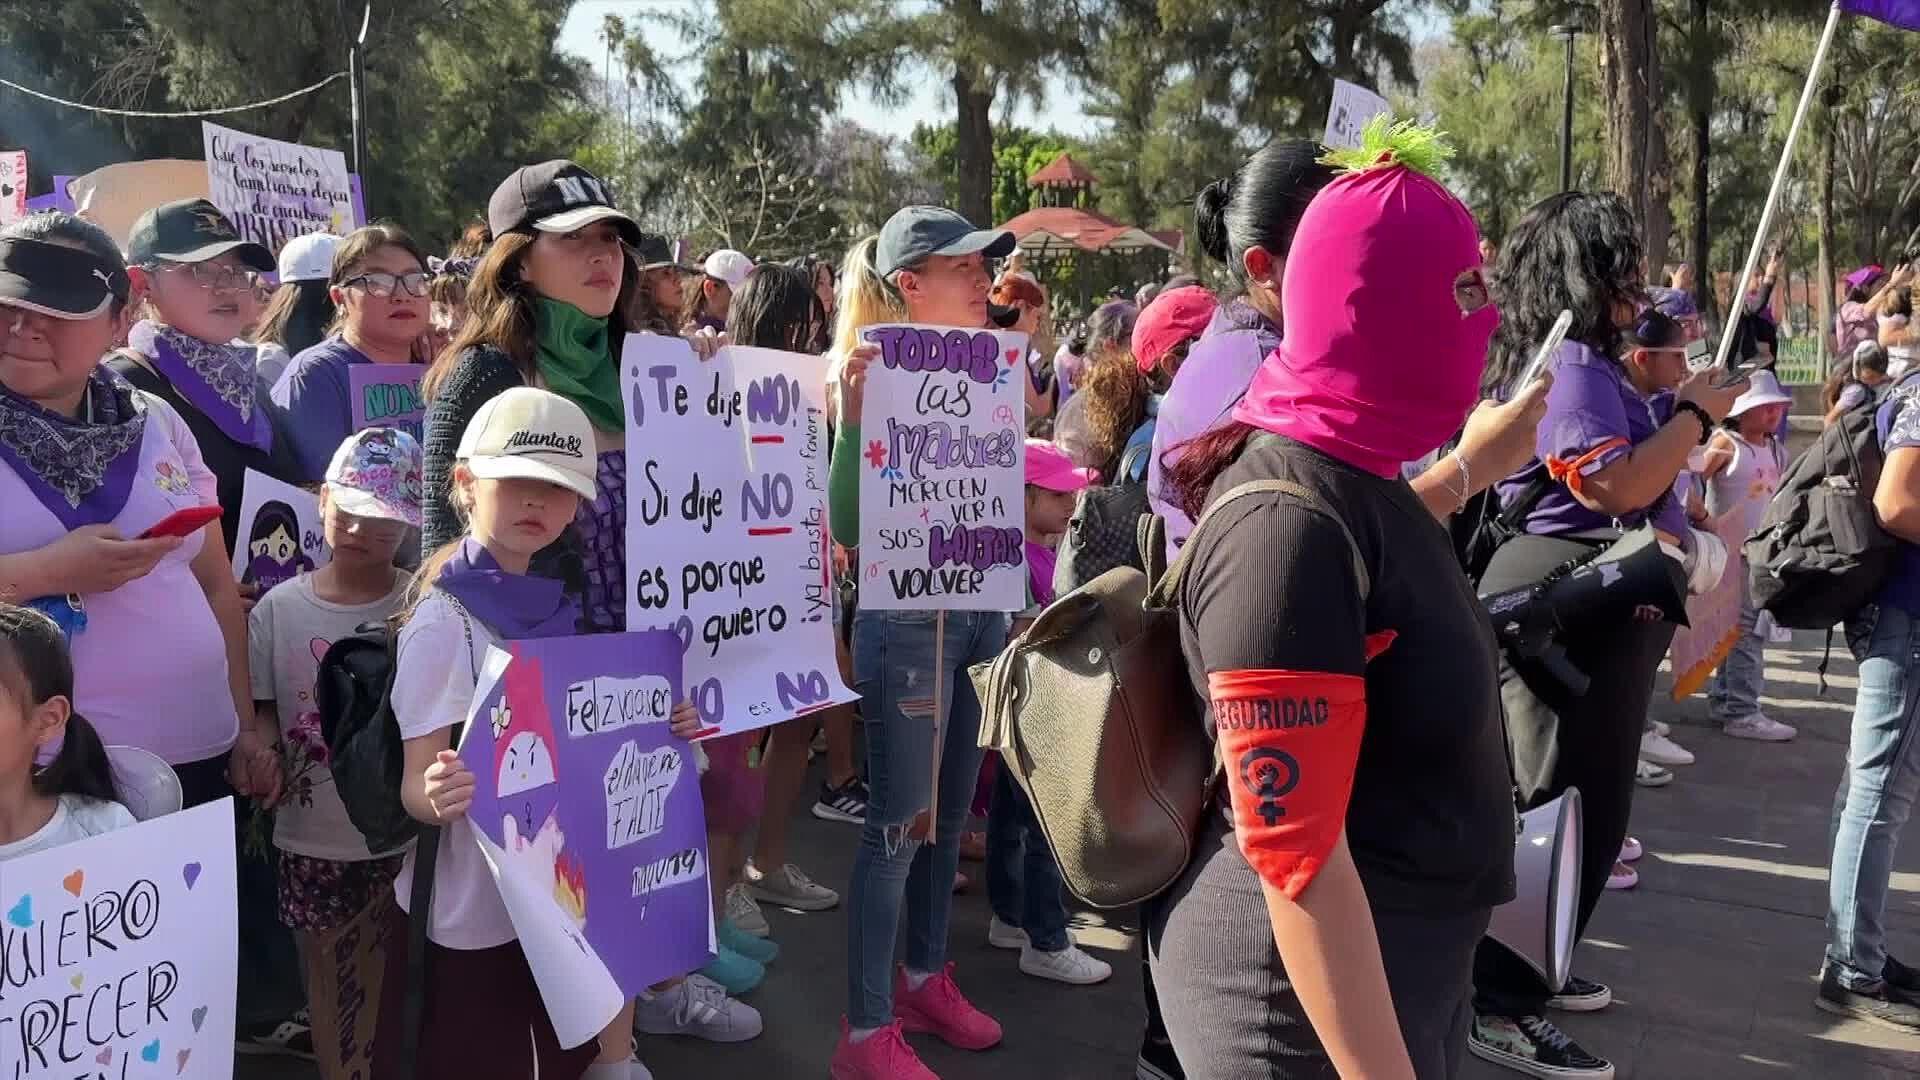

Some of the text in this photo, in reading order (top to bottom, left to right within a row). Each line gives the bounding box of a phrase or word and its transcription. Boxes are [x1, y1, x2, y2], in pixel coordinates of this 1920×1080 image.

[864, 327, 999, 384] TODAS
[363, 382, 425, 421] NUN
[707, 371, 742, 427] dije
[747, 373, 800, 428] NO!
[916, 373, 971, 418] las
[641, 460, 793, 533] Si dije NO
[806, 465, 824, 491] por
[951, 495, 1005, 524] VER A
[303, 530, 324, 552] 8M
[879, 527, 924, 551] SUS
[637, 556, 765, 610] es porque
[888, 567, 985, 600] VOLVER
[703, 605, 787, 657] quiero
[748, 702, 773, 717] es
[776, 669, 830, 711] NO
[0, 879, 160, 987] UIERO
[0, 960, 178, 1074] RECER
